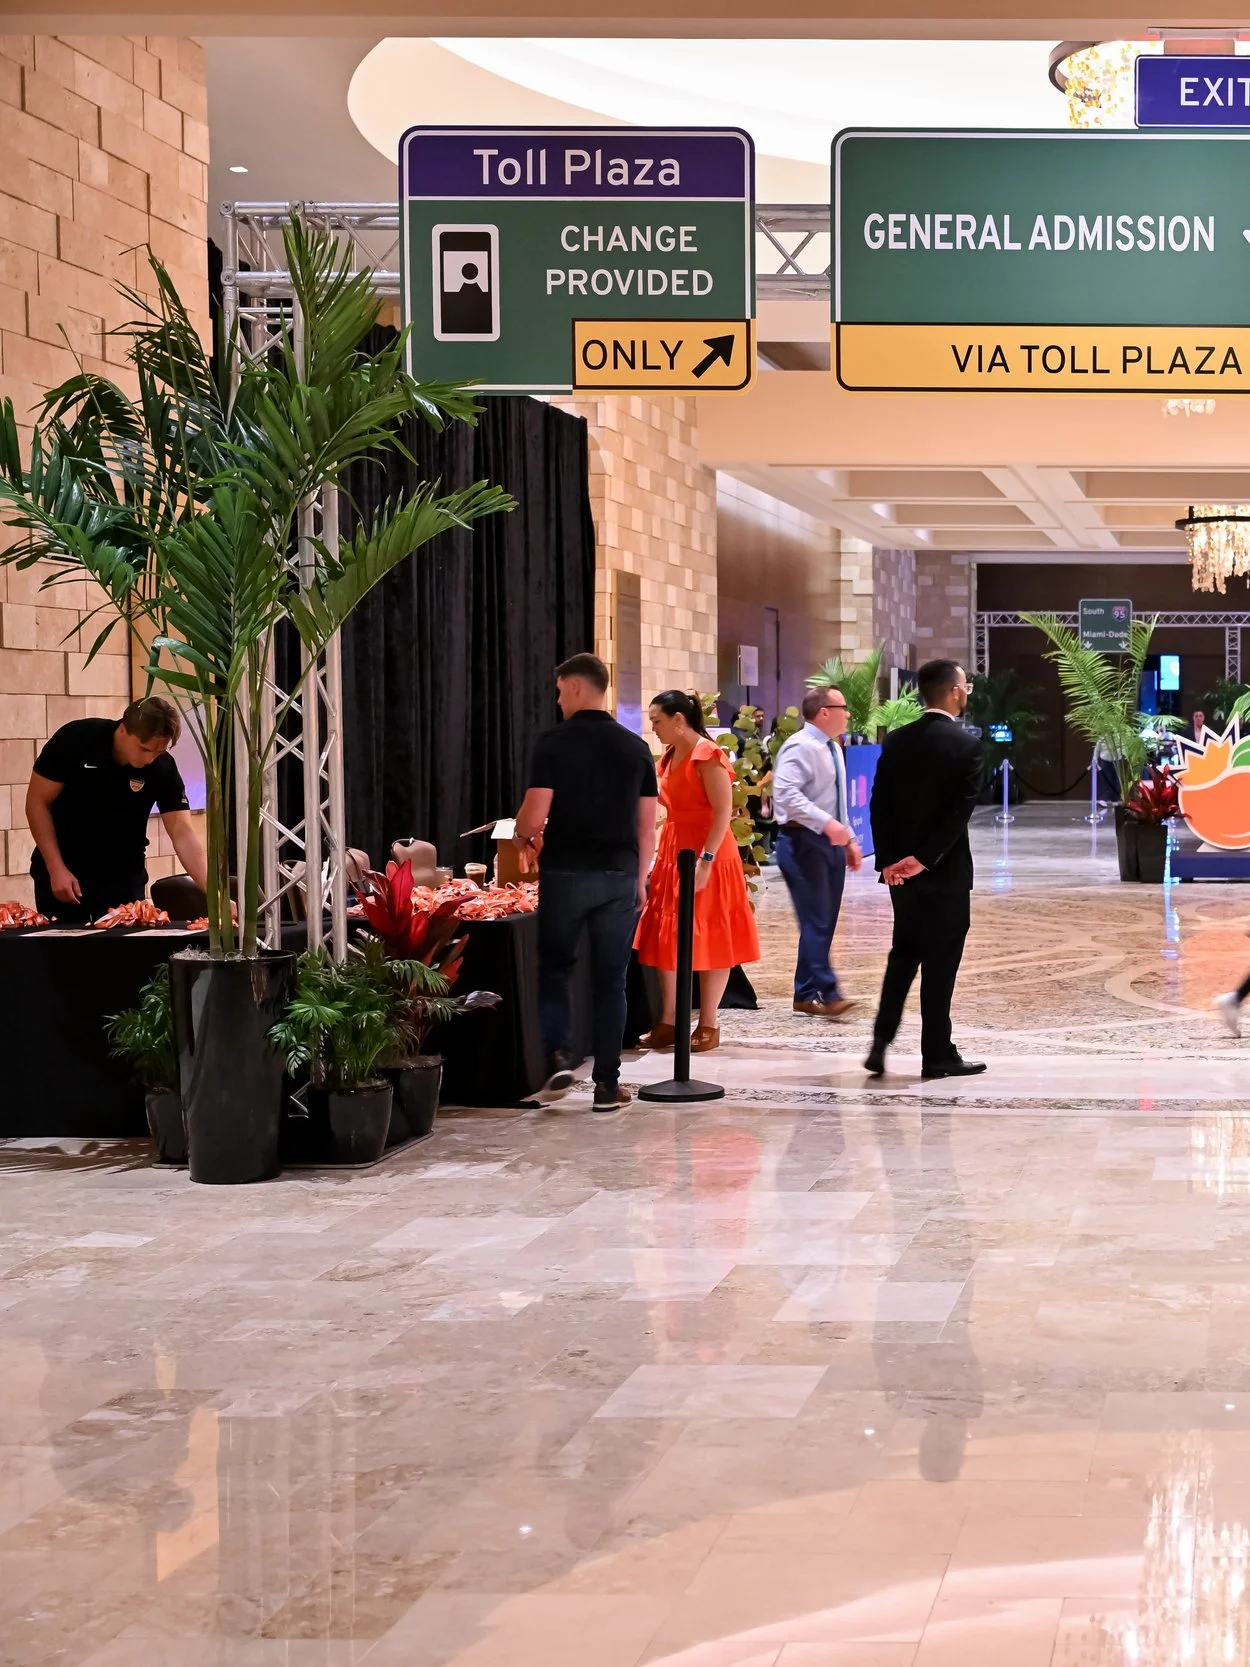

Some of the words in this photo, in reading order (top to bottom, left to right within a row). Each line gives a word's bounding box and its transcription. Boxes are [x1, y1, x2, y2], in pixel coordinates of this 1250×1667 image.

[473, 148, 547, 186] Toll
[564, 149, 681, 187] Plaza
[560, 225, 698, 252] CHANGE
[863, 212, 1022, 251] GENERAL
[1028, 214, 1216, 252] ADMISSION
[546, 269, 714, 296] PROVIDED
[581, 340, 684, 371] ONLY
[951, 345, 1010, 374] VIA
[1020, 345, 1110, 375] TOLL
[1121, 346, 1243, 376] PLAZA
[1083, 607, 1105, 615] South
[1113, 610, 1126, 619] 95
